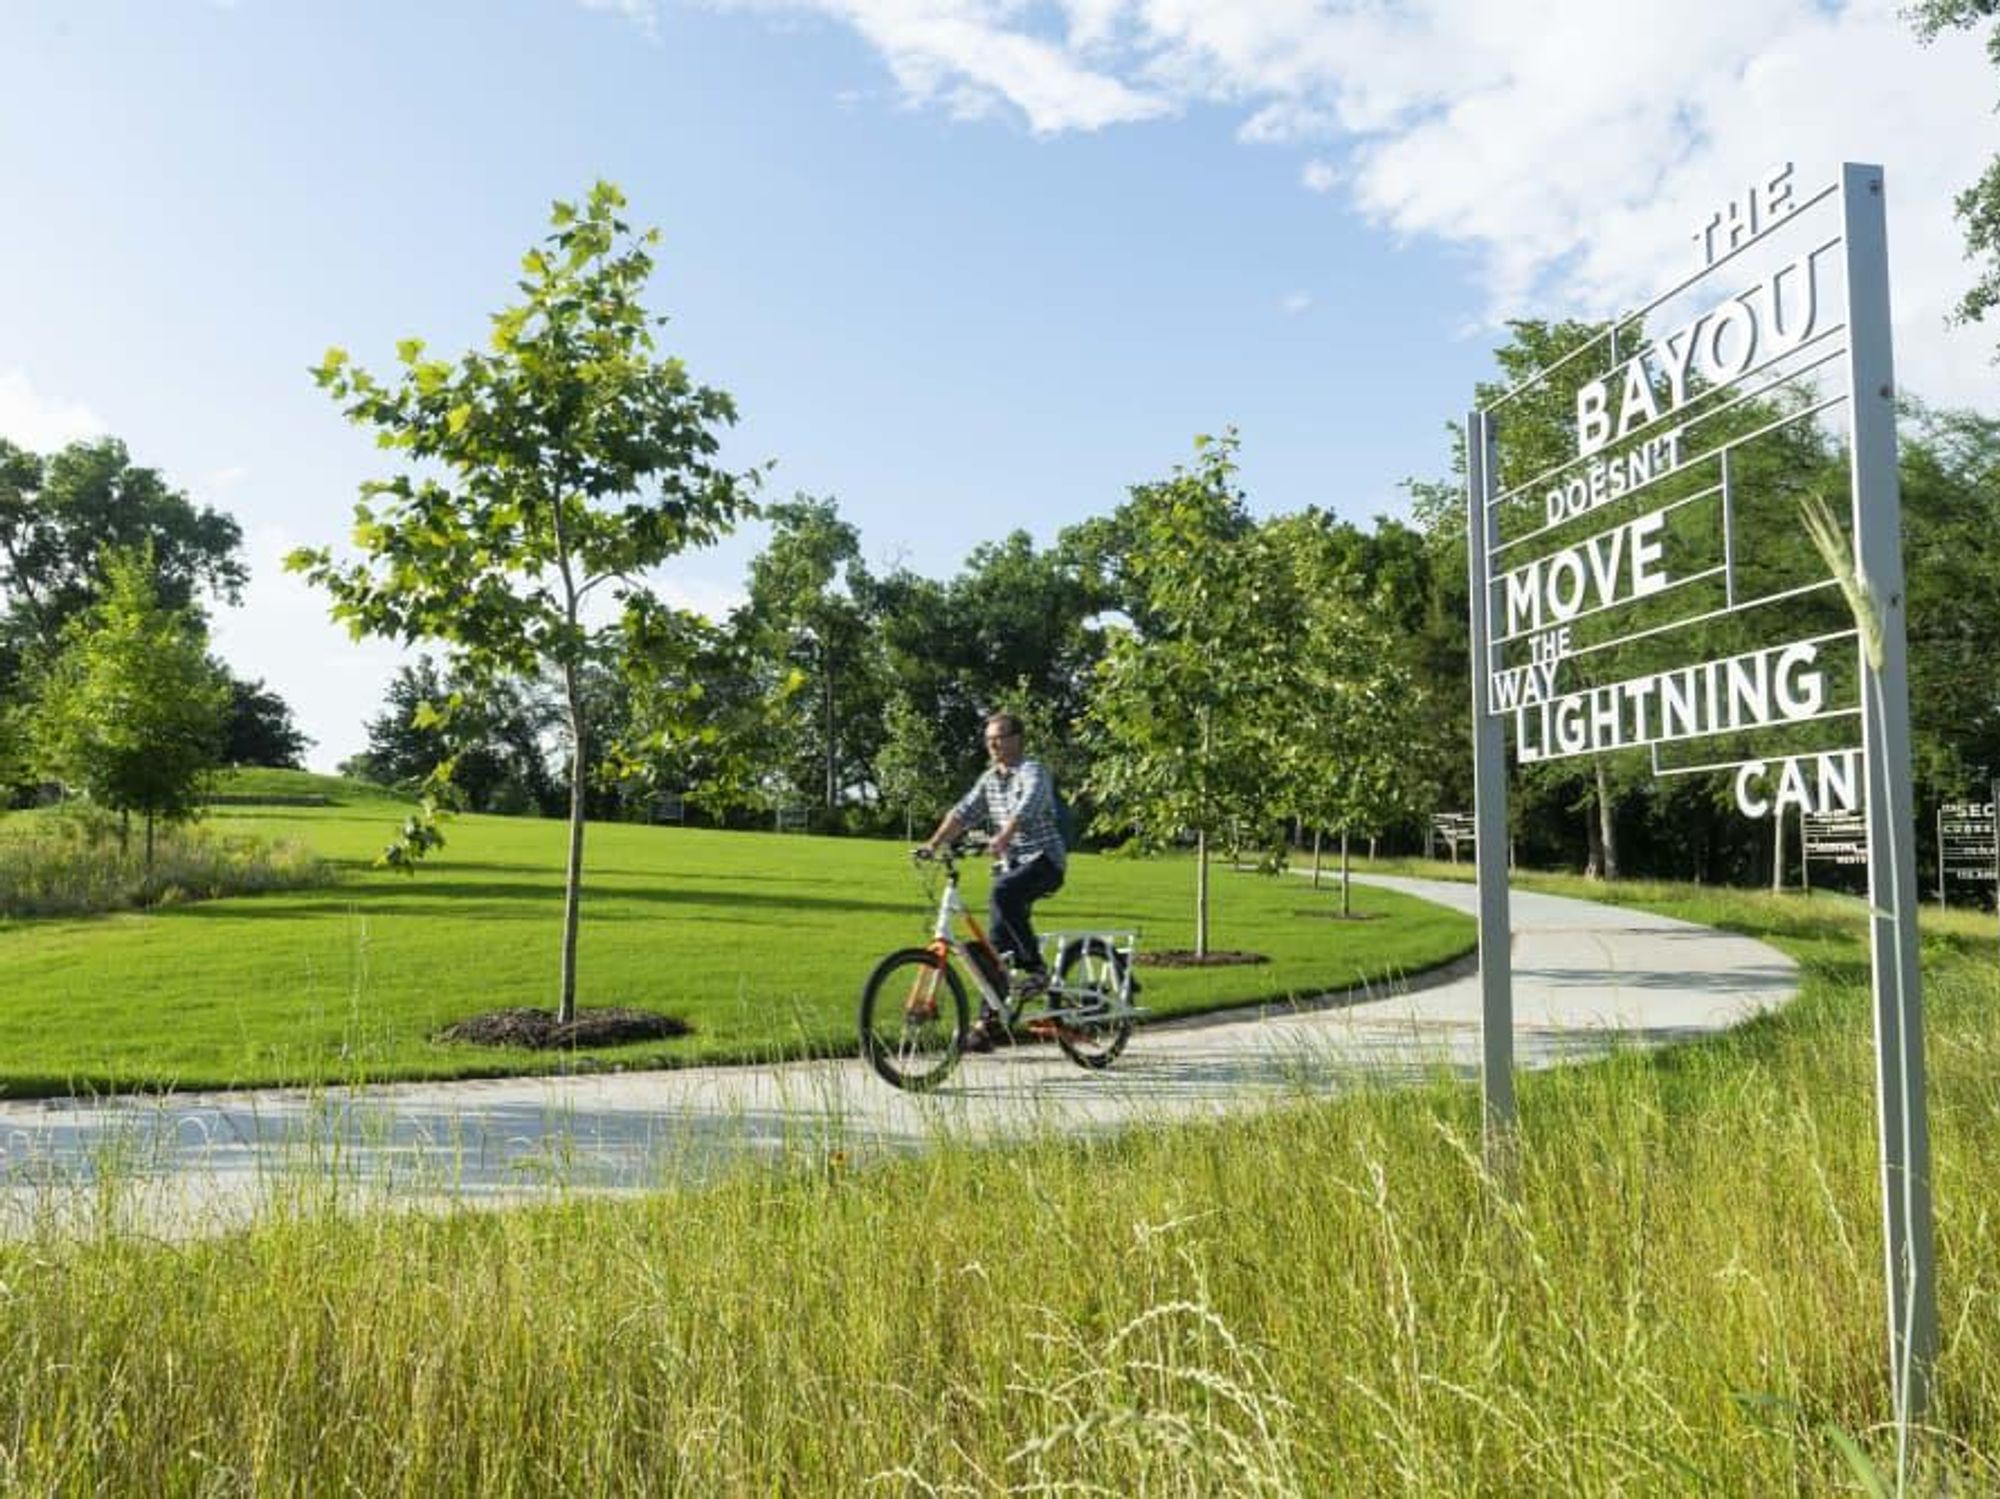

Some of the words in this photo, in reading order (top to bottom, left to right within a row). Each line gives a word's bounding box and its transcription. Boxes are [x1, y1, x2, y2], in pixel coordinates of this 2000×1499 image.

[1692, 161, 1795, 264] THE
[1577, 251, 1816, 459] BAYOU
[1547, 428, 1685, 526] DOESN'T
[1507, 511, 1667, 637] MOVE
[1493, 658, 1559, 709] WAY
[1528, 627, 1570, 665] THE
[1517, 643, 1824, 763] LIGHTNING
[1735, 755, 1856, 818] CAN
